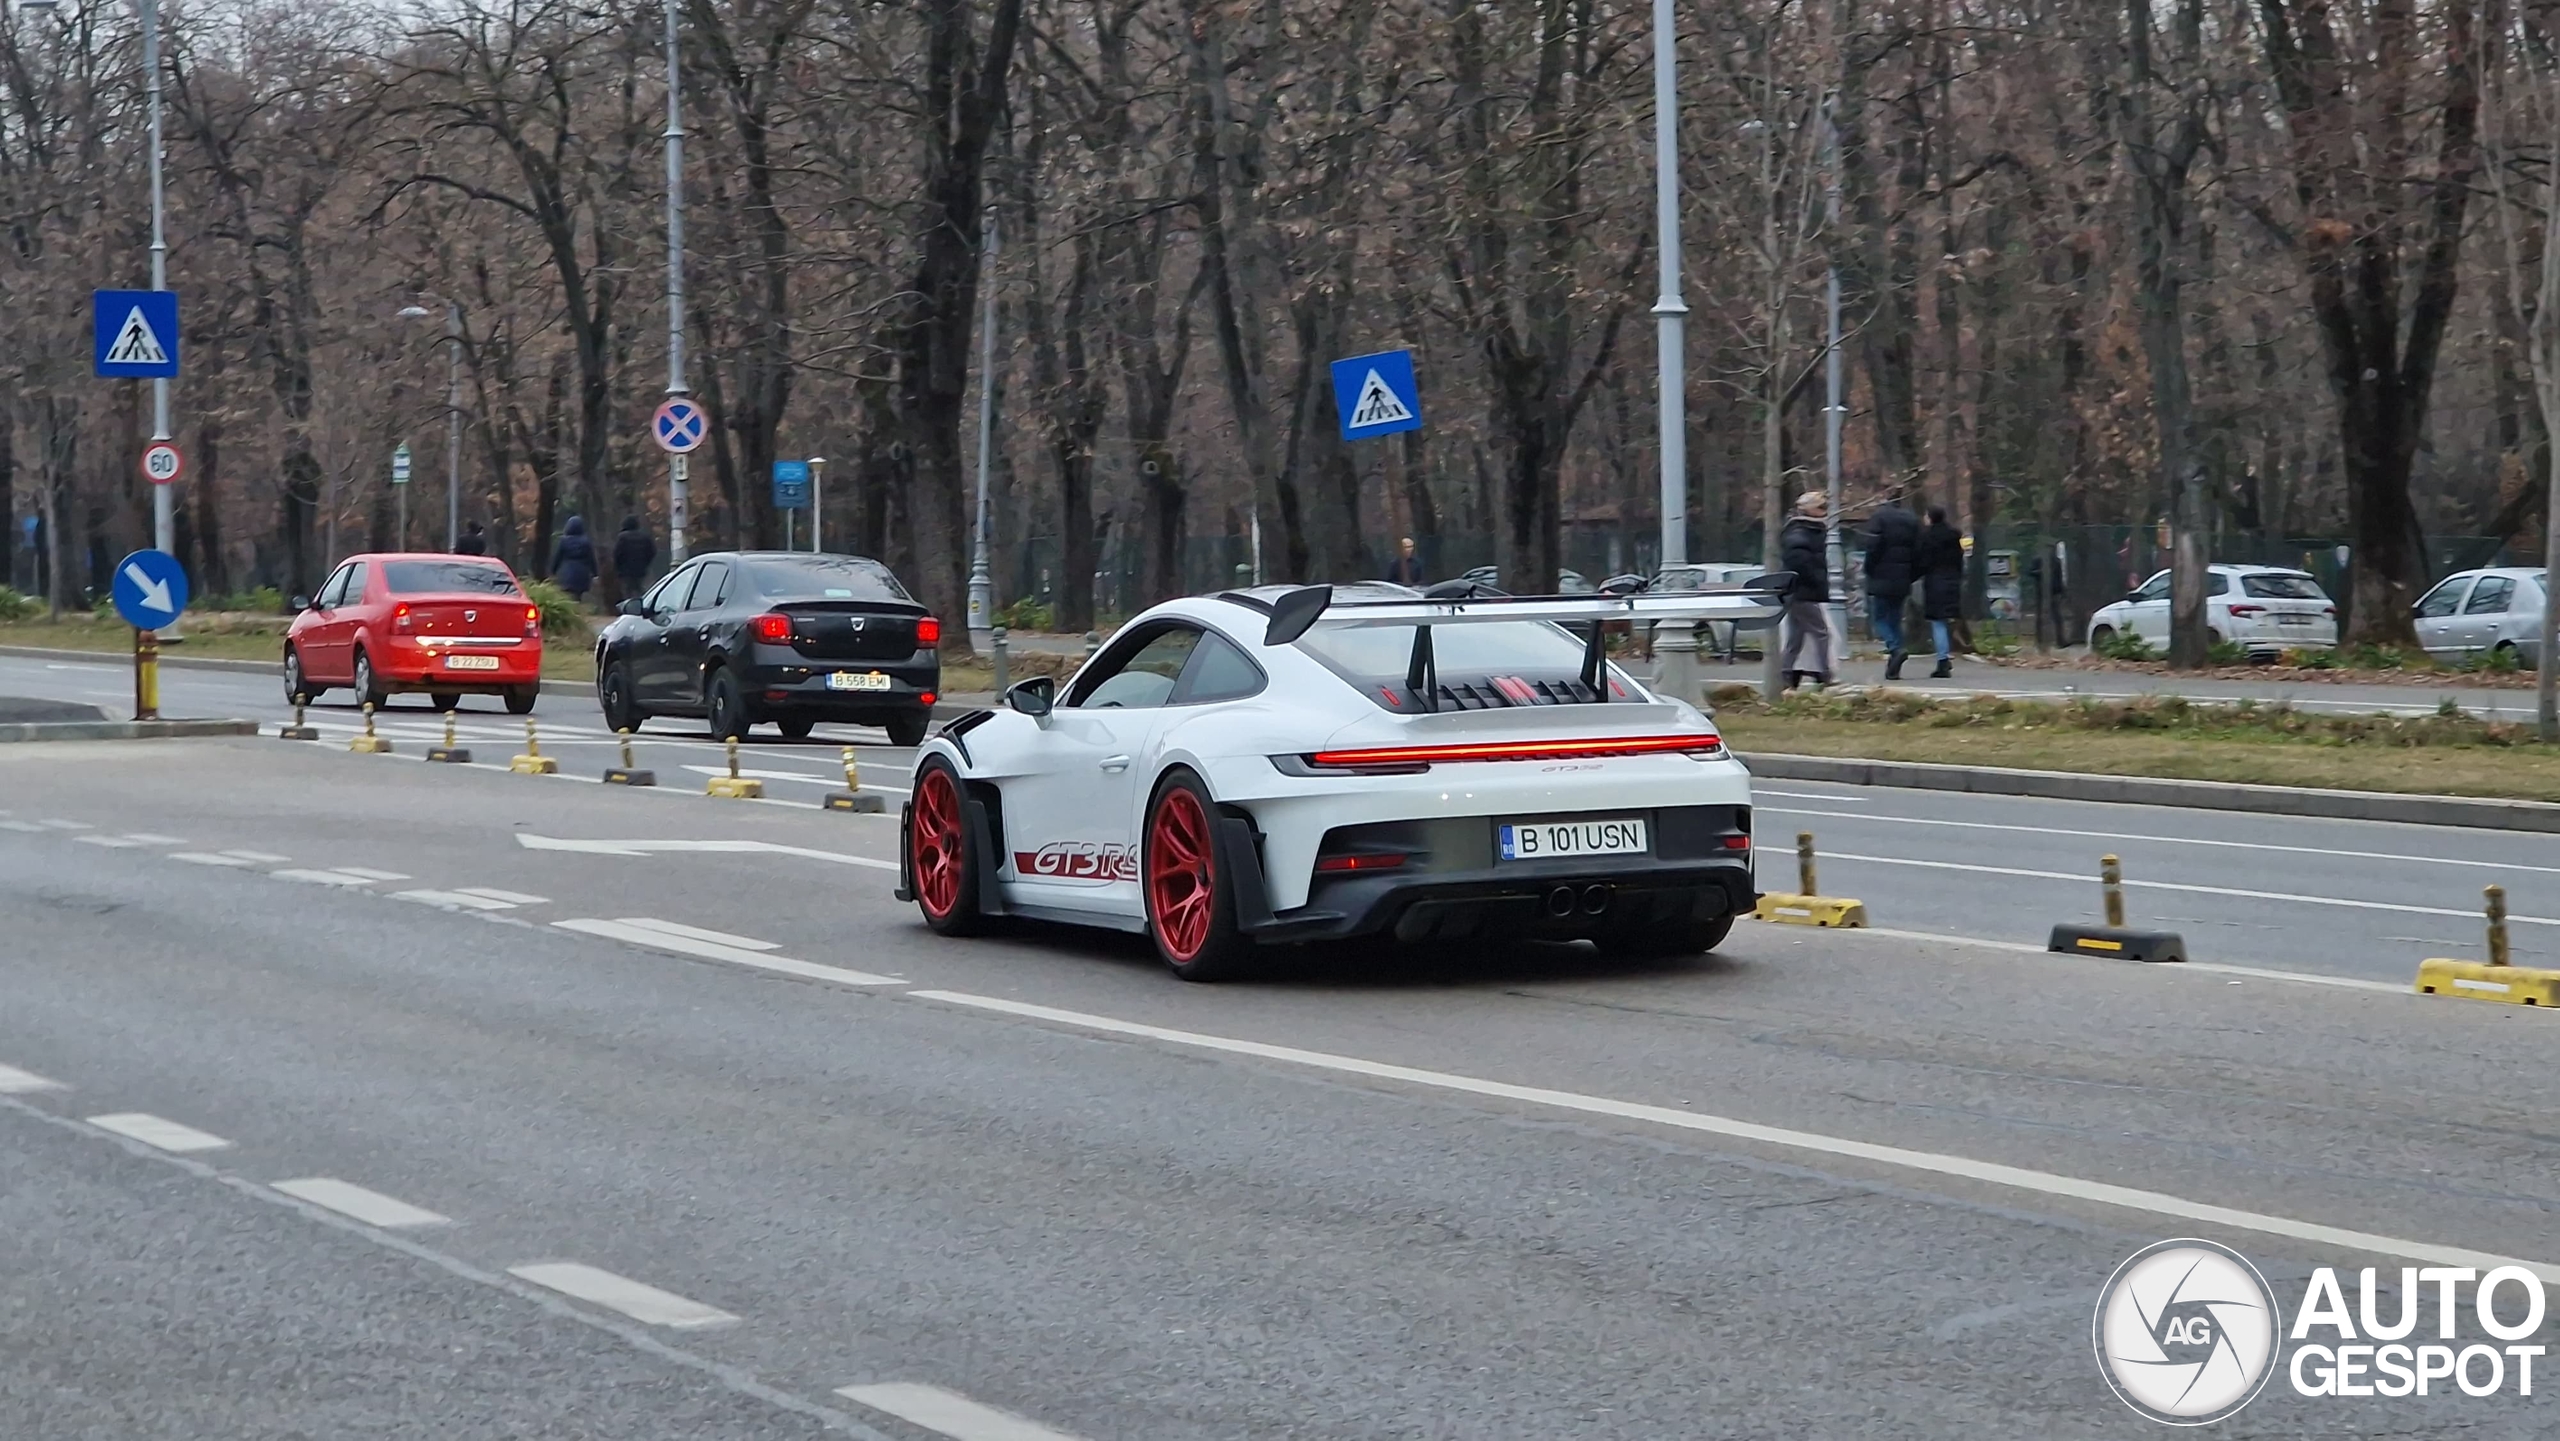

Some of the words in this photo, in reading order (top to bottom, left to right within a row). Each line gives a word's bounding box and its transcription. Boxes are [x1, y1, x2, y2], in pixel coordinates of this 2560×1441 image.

[150, 453, 174, 473] 60
[462, 657, 473, 667] 22
[835, 675, 844, 686] B
[868, 675, 887, 688] EMI
[1520, 828, 1539, 854] B
[1547, 826, 1580, 852] 101
[1585, 823, 1638, 850] USN
[1502, 843, 1514, 855] RO
